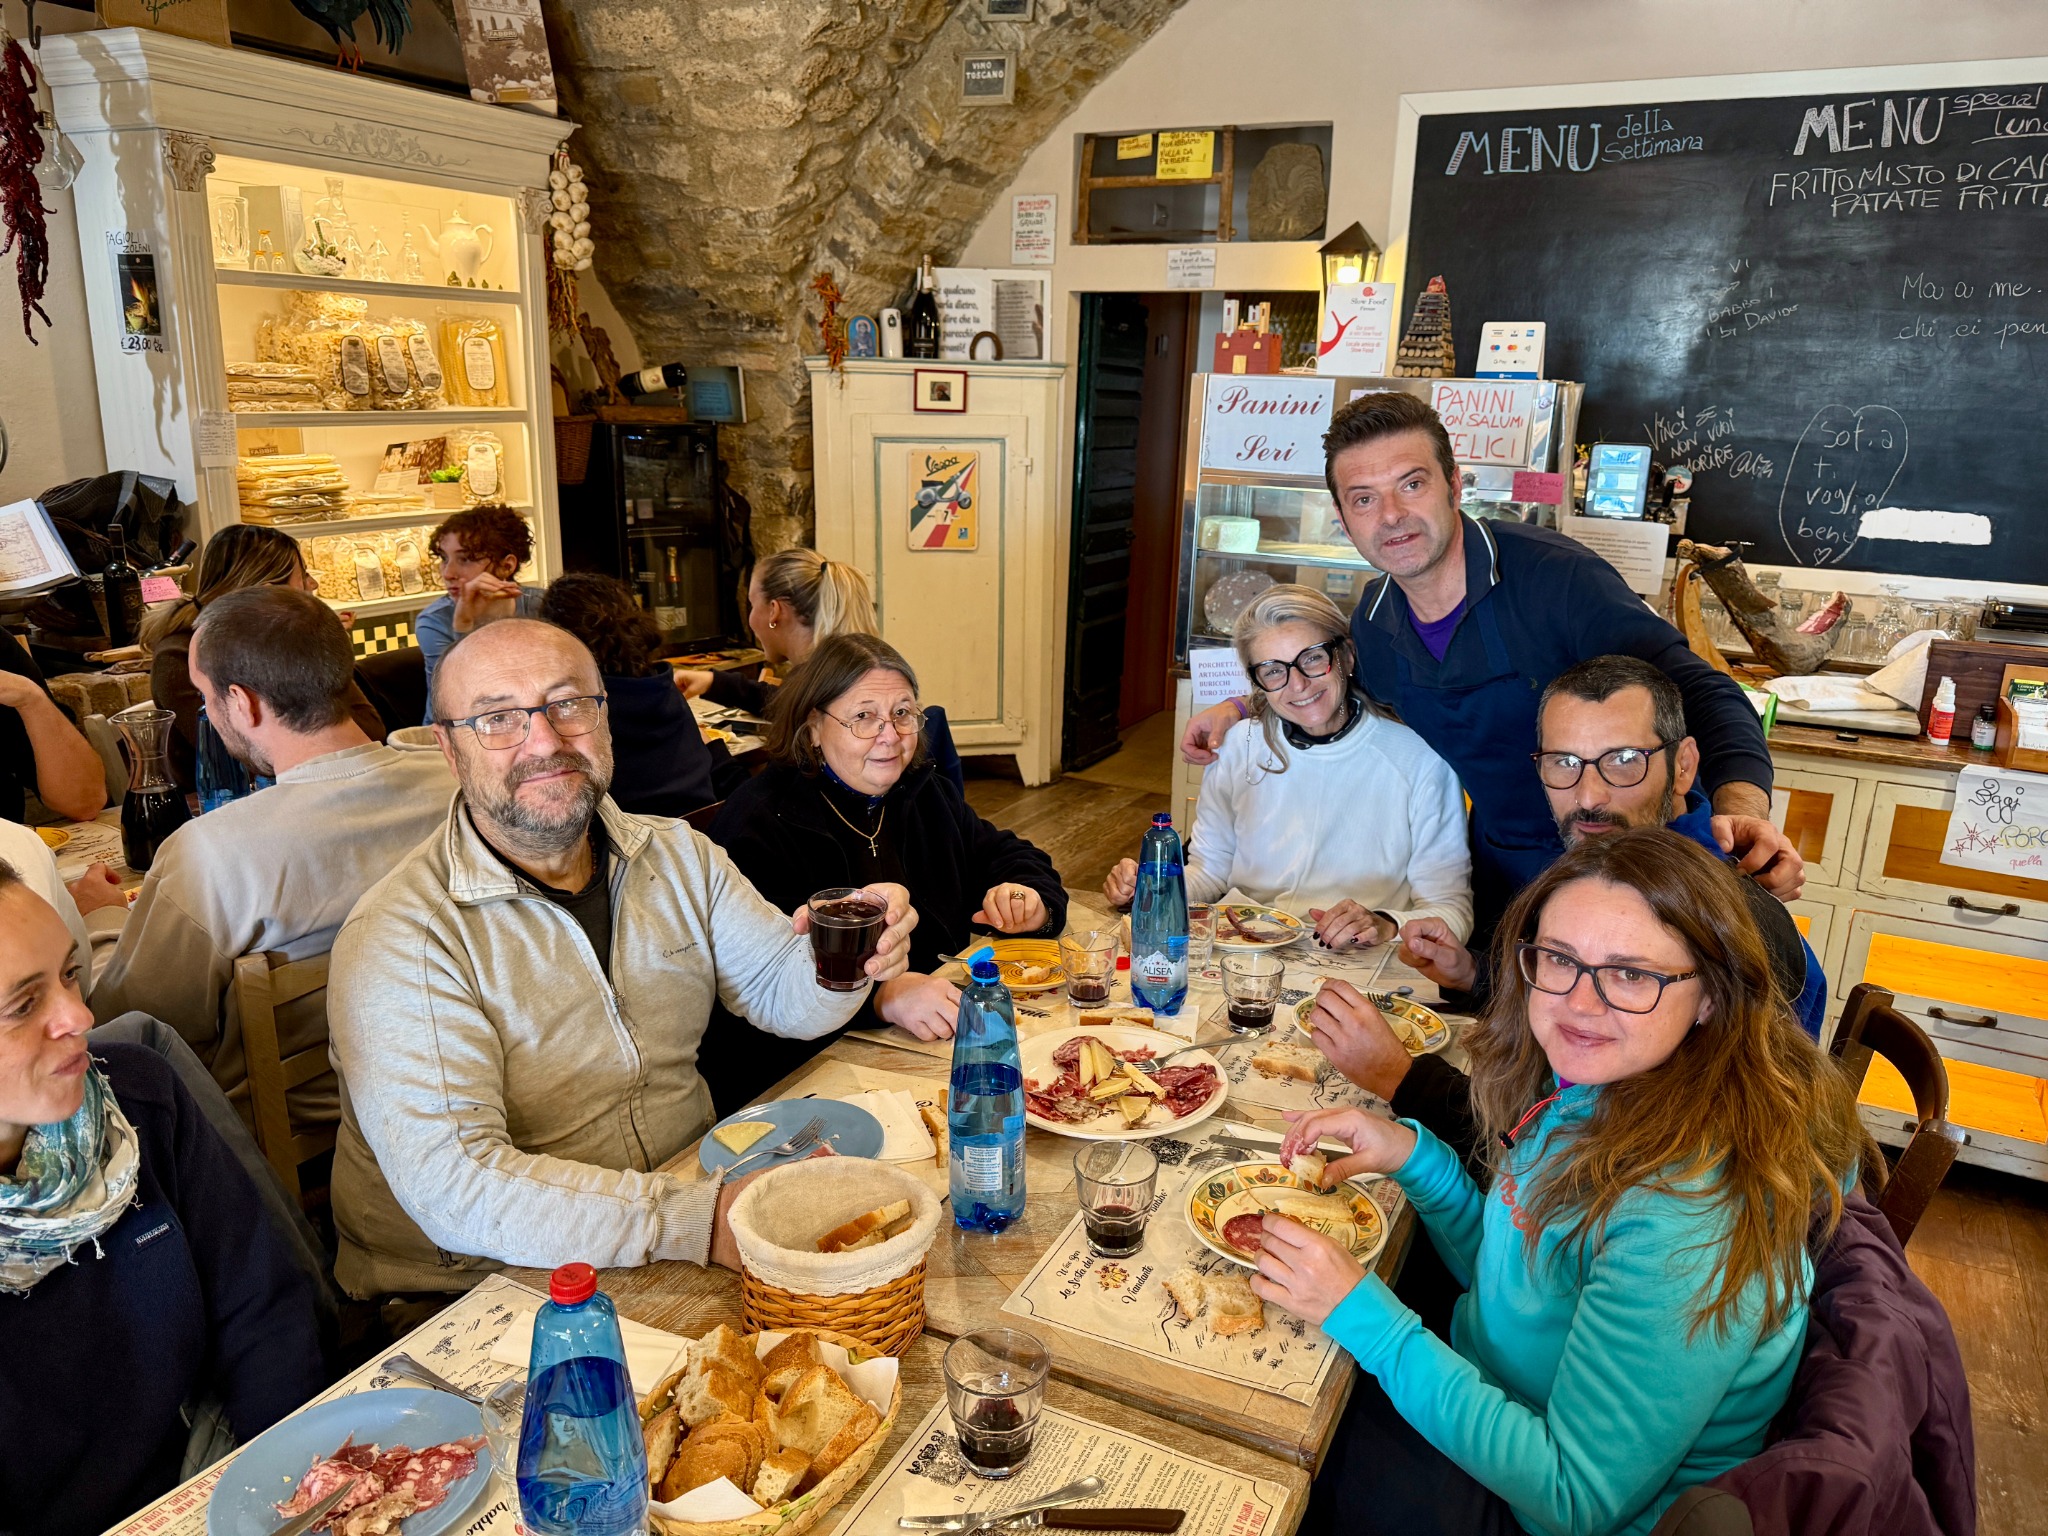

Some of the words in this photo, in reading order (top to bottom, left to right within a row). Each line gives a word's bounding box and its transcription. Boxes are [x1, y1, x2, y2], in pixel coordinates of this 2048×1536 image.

[965, 70, 1004, 79] TOSCANO
[972, 61, 992, 69] VINO
[1953, 86, 2042, 116] special
[1616, 109, 1674, 139] della
[1793, 97, 1949, 155] MENU
[1445, 123, 1602, 175] MENU
[1601, 134, 1704, 162] Settimana
[1769, 168, 1854, 206] FRITTO
[1858, 161, 1945, 189] MISTO
[1956, 163, 1982, 182] DI
[1830, 189, 1943, 217] PATATE
[105, 231, 140, 246] FAGIOLI
[943, 285, 976, 297] qualcuno
[1902, 272, 1945, 300] Ma
[1954, 281, 1974, 299] a
[1893, 315, 1937, 340] chi
[1217, 385, 1327, 416] Panini
[1436, 385, 1515, 414] PANINI
[1437, 411, 1464, 427] ON
[1466, 413, 1524, 429] SALUMI
[1236, 434, 1299, 462] Seri
[925, 455, 961, 477] Vespa
[1806, 480, 1876, 515] voglio
[1198, 661, 1237, 669] PORCHETTA
[2009, 855, 2043, 871] quella
[1143, 966, 1173, 975] ALISEA
[1059, 1286, 1076, 1300] La
[1069, 1264, 1089, 1290] Sosta
[1081, 1255, 1096, 1271] del
[1121, 1263, 1156, 1304] Viandante
